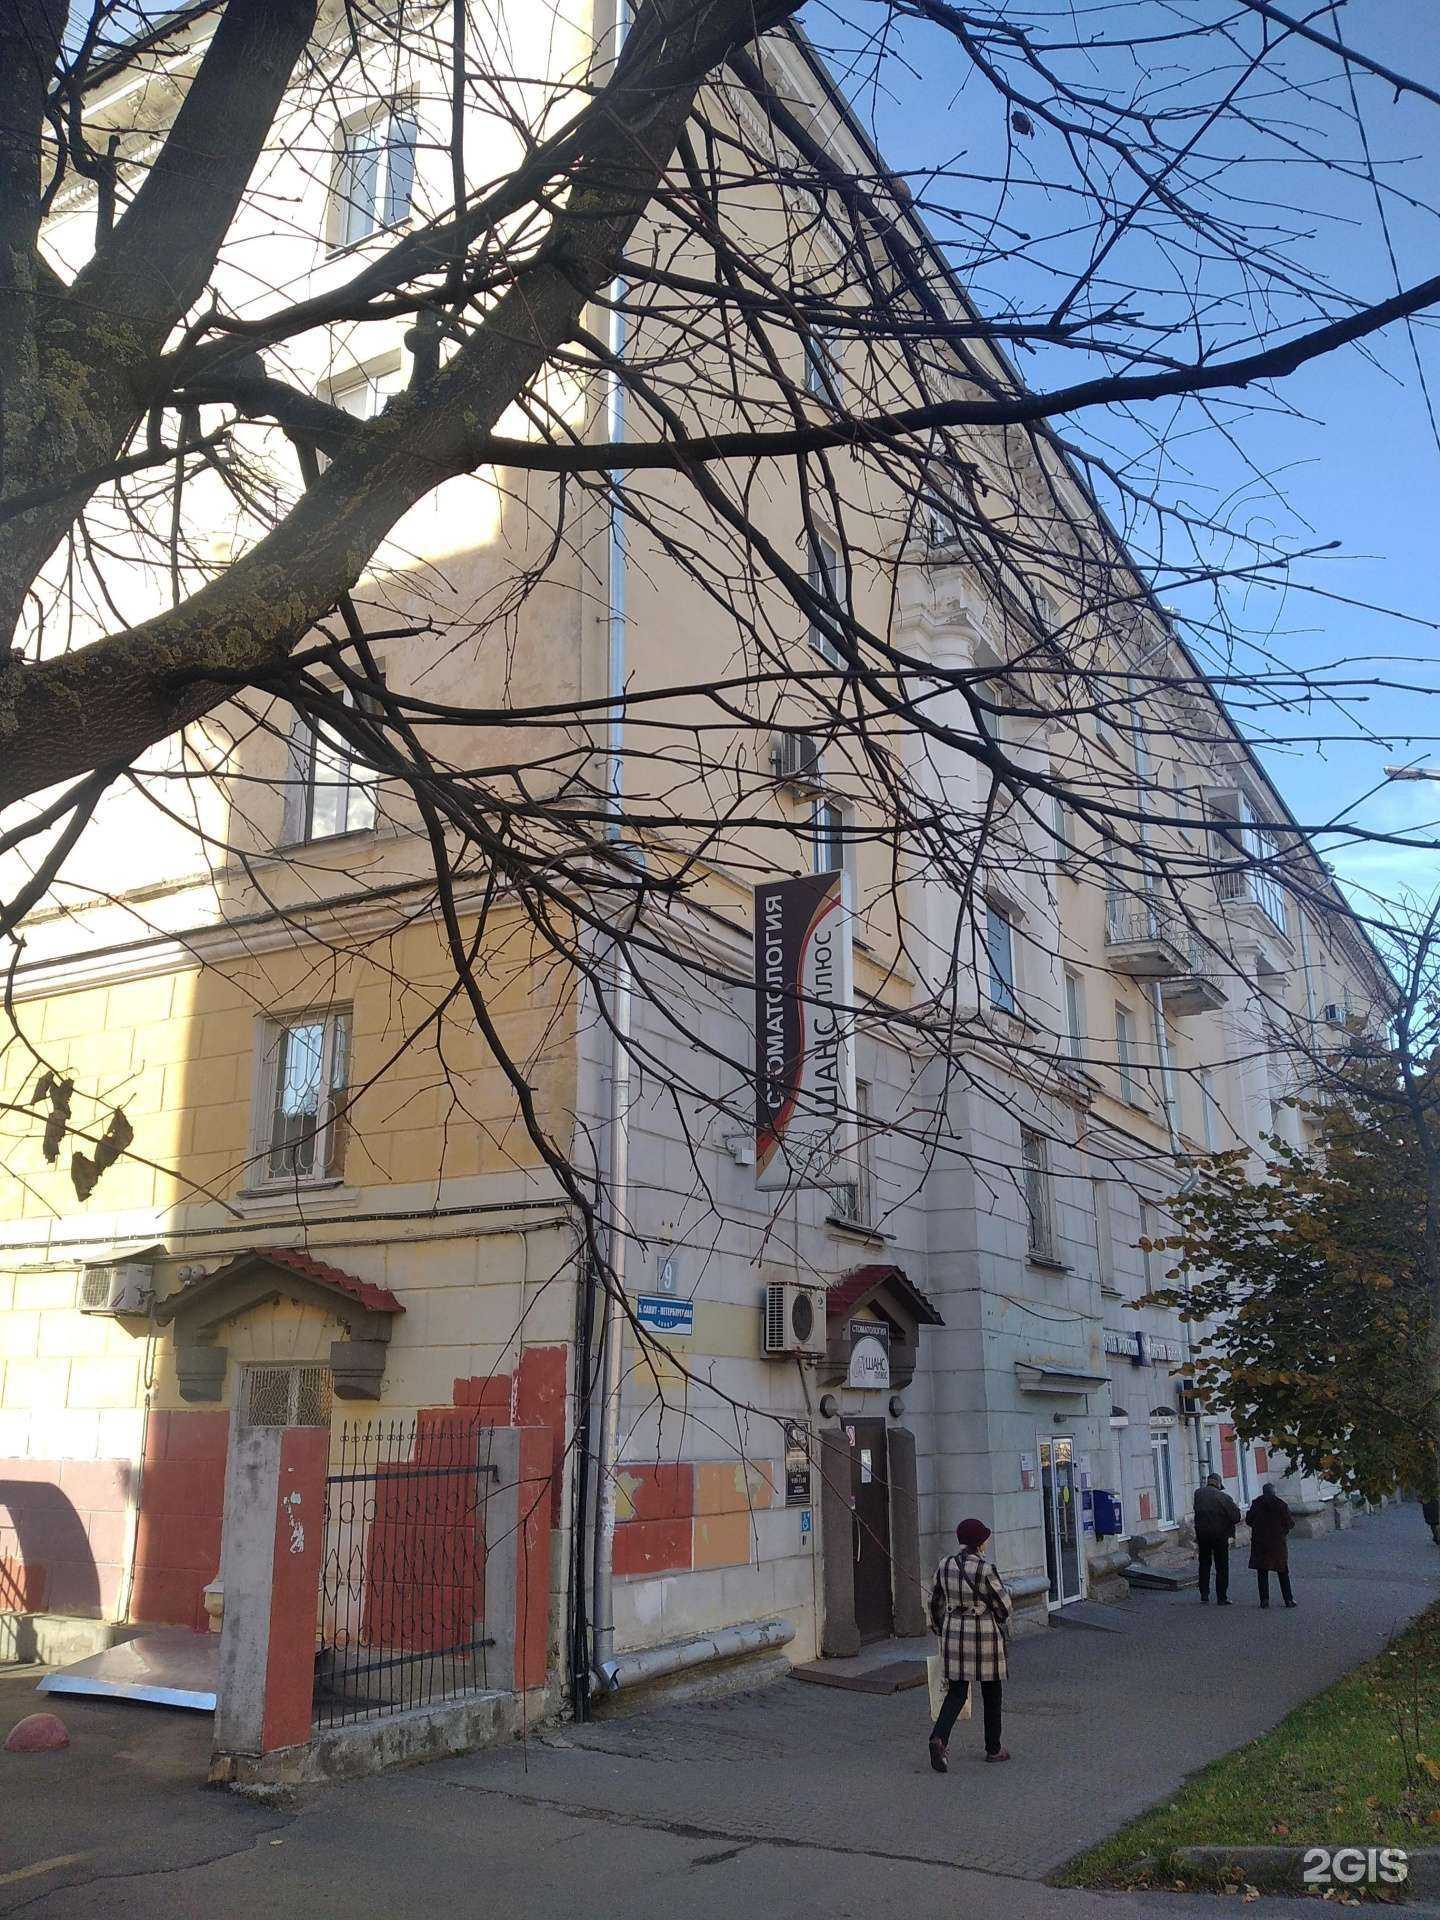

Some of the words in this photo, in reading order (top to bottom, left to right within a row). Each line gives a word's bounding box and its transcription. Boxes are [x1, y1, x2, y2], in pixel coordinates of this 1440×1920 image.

[814, 930, 834, 1008] ПЛЮС
[765, 894, 785, 1110] СТОМАТОЛОГИЯ
[814, 1018, 838, 1118] ШАНС
[664, 1262, 673, 1289] 9
[851, 1324, 887, 1336] СТОМАТОЛОГИЯ
[865, 1357, 886, 1371] ШАНС
